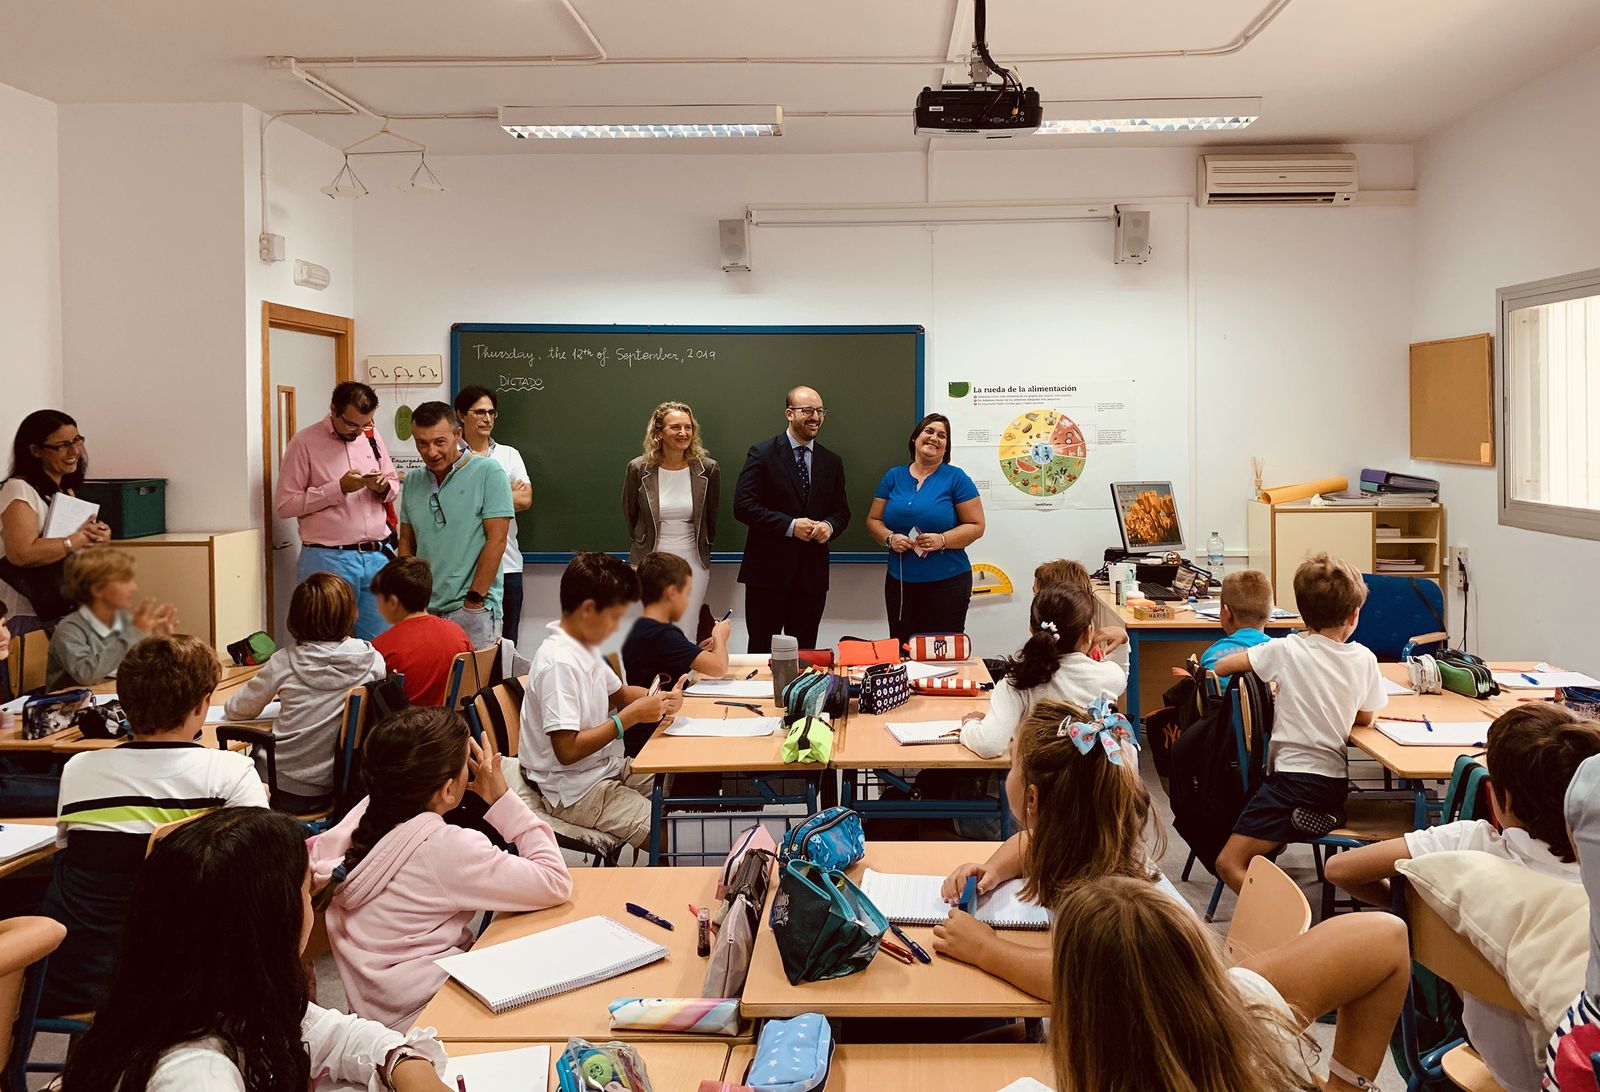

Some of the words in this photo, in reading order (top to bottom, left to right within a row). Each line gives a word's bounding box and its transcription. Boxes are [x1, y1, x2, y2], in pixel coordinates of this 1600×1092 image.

[548, 346, 567, 360] the
[572, 347, 594, 360] 12th
[597, 347, 609, 367] of
[686, 347, 716, 360] 2019
[1018, 385, 1026, 393] la
[1027, 384, 1077, 393] alimentación
